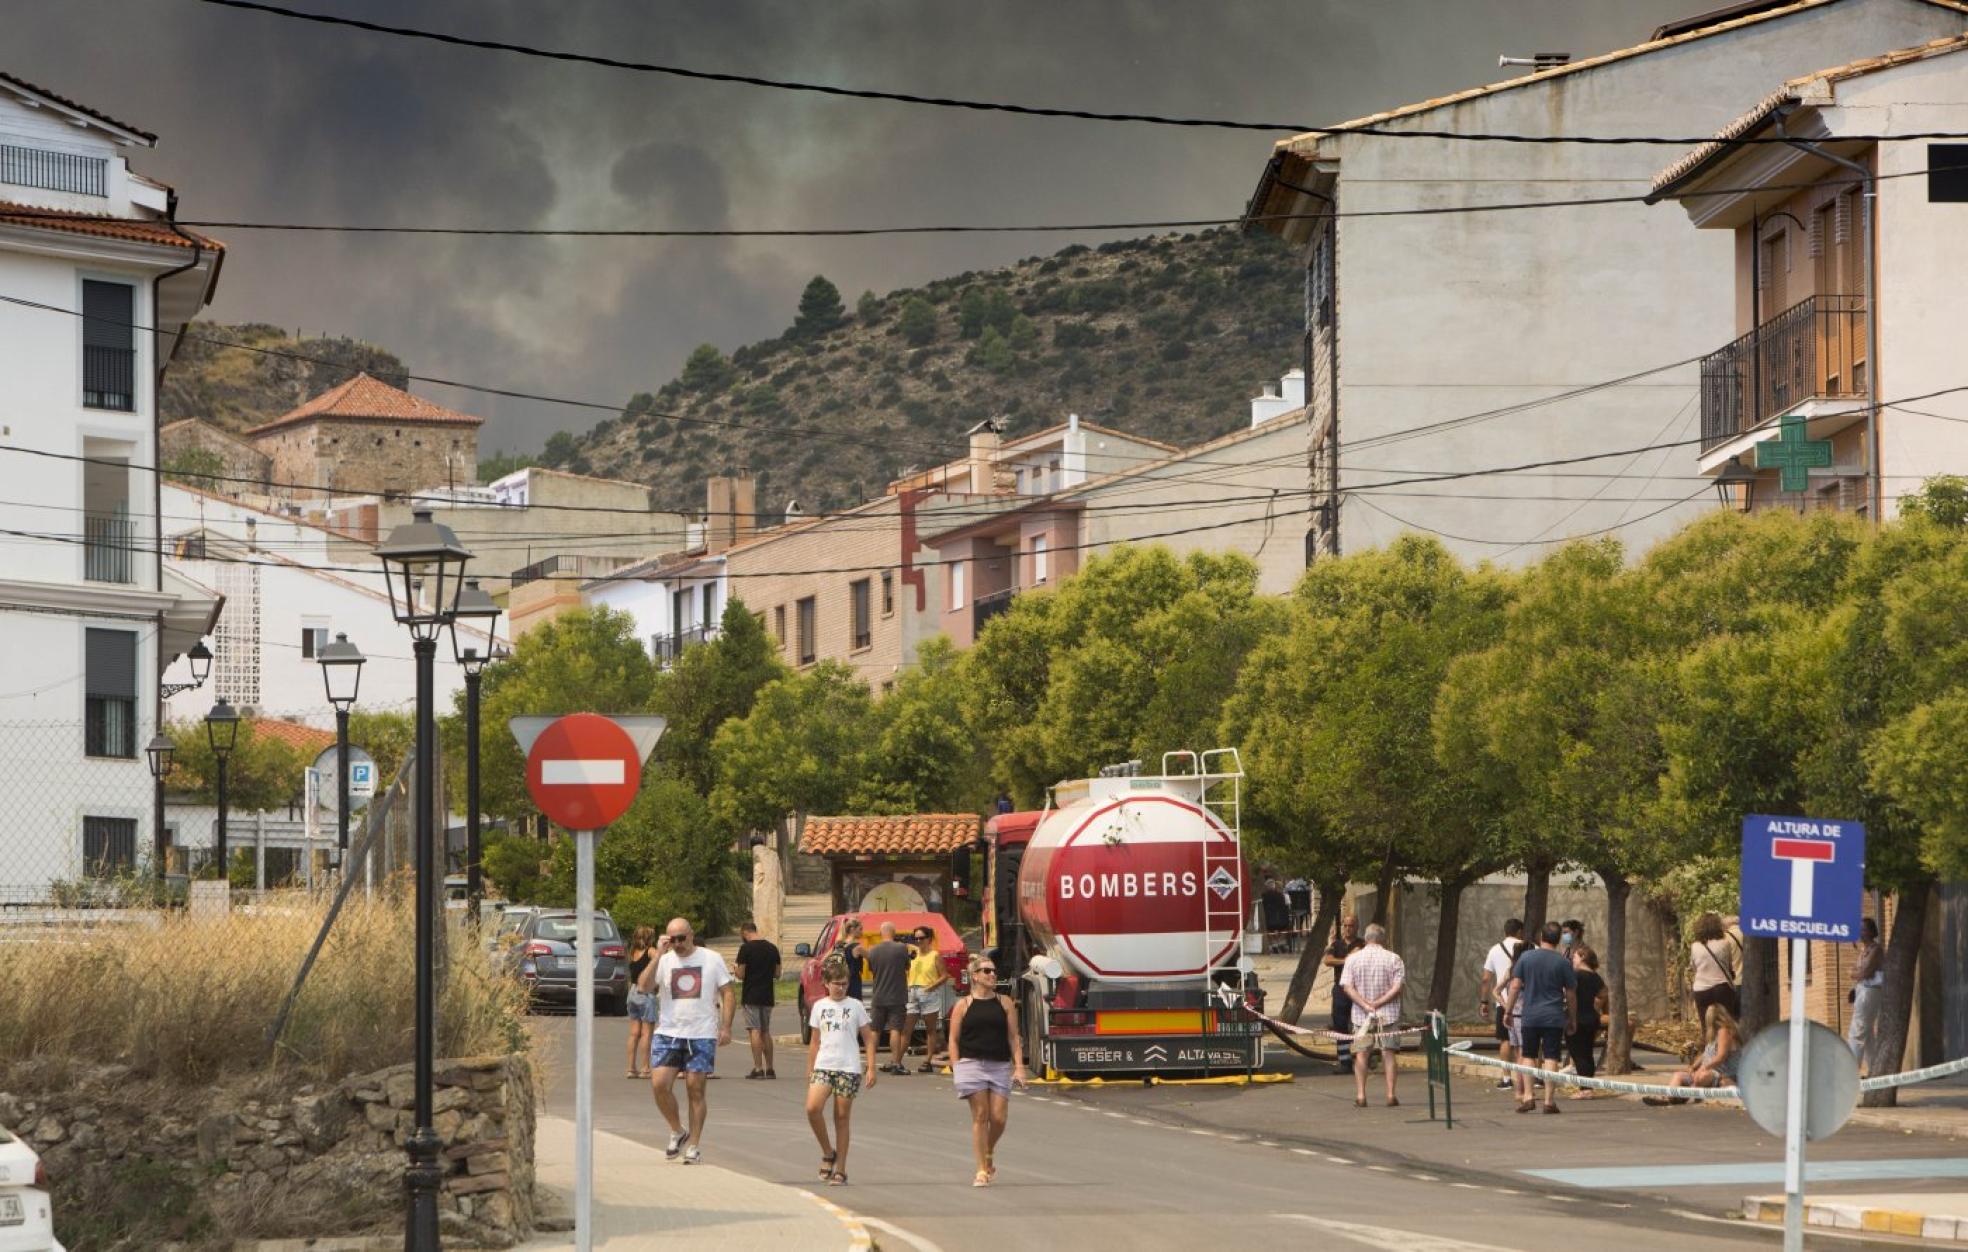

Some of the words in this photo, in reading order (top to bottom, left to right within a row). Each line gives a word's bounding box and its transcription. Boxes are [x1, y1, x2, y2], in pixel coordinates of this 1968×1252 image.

[356, 768, 367, 781] P
[1767, 821, 1820, 836] ALTURA
[1822, 825, 1842, 837] DE
[1060, 872, 1197, 899] BOMBERS
[1751, 918, 1778, 931] LAS
[1780, 920, 1850, 936] ESCUELAS
[1077, 1050, 1122, 1062] BESER
[1126, 1050, 1134, 1062] &
